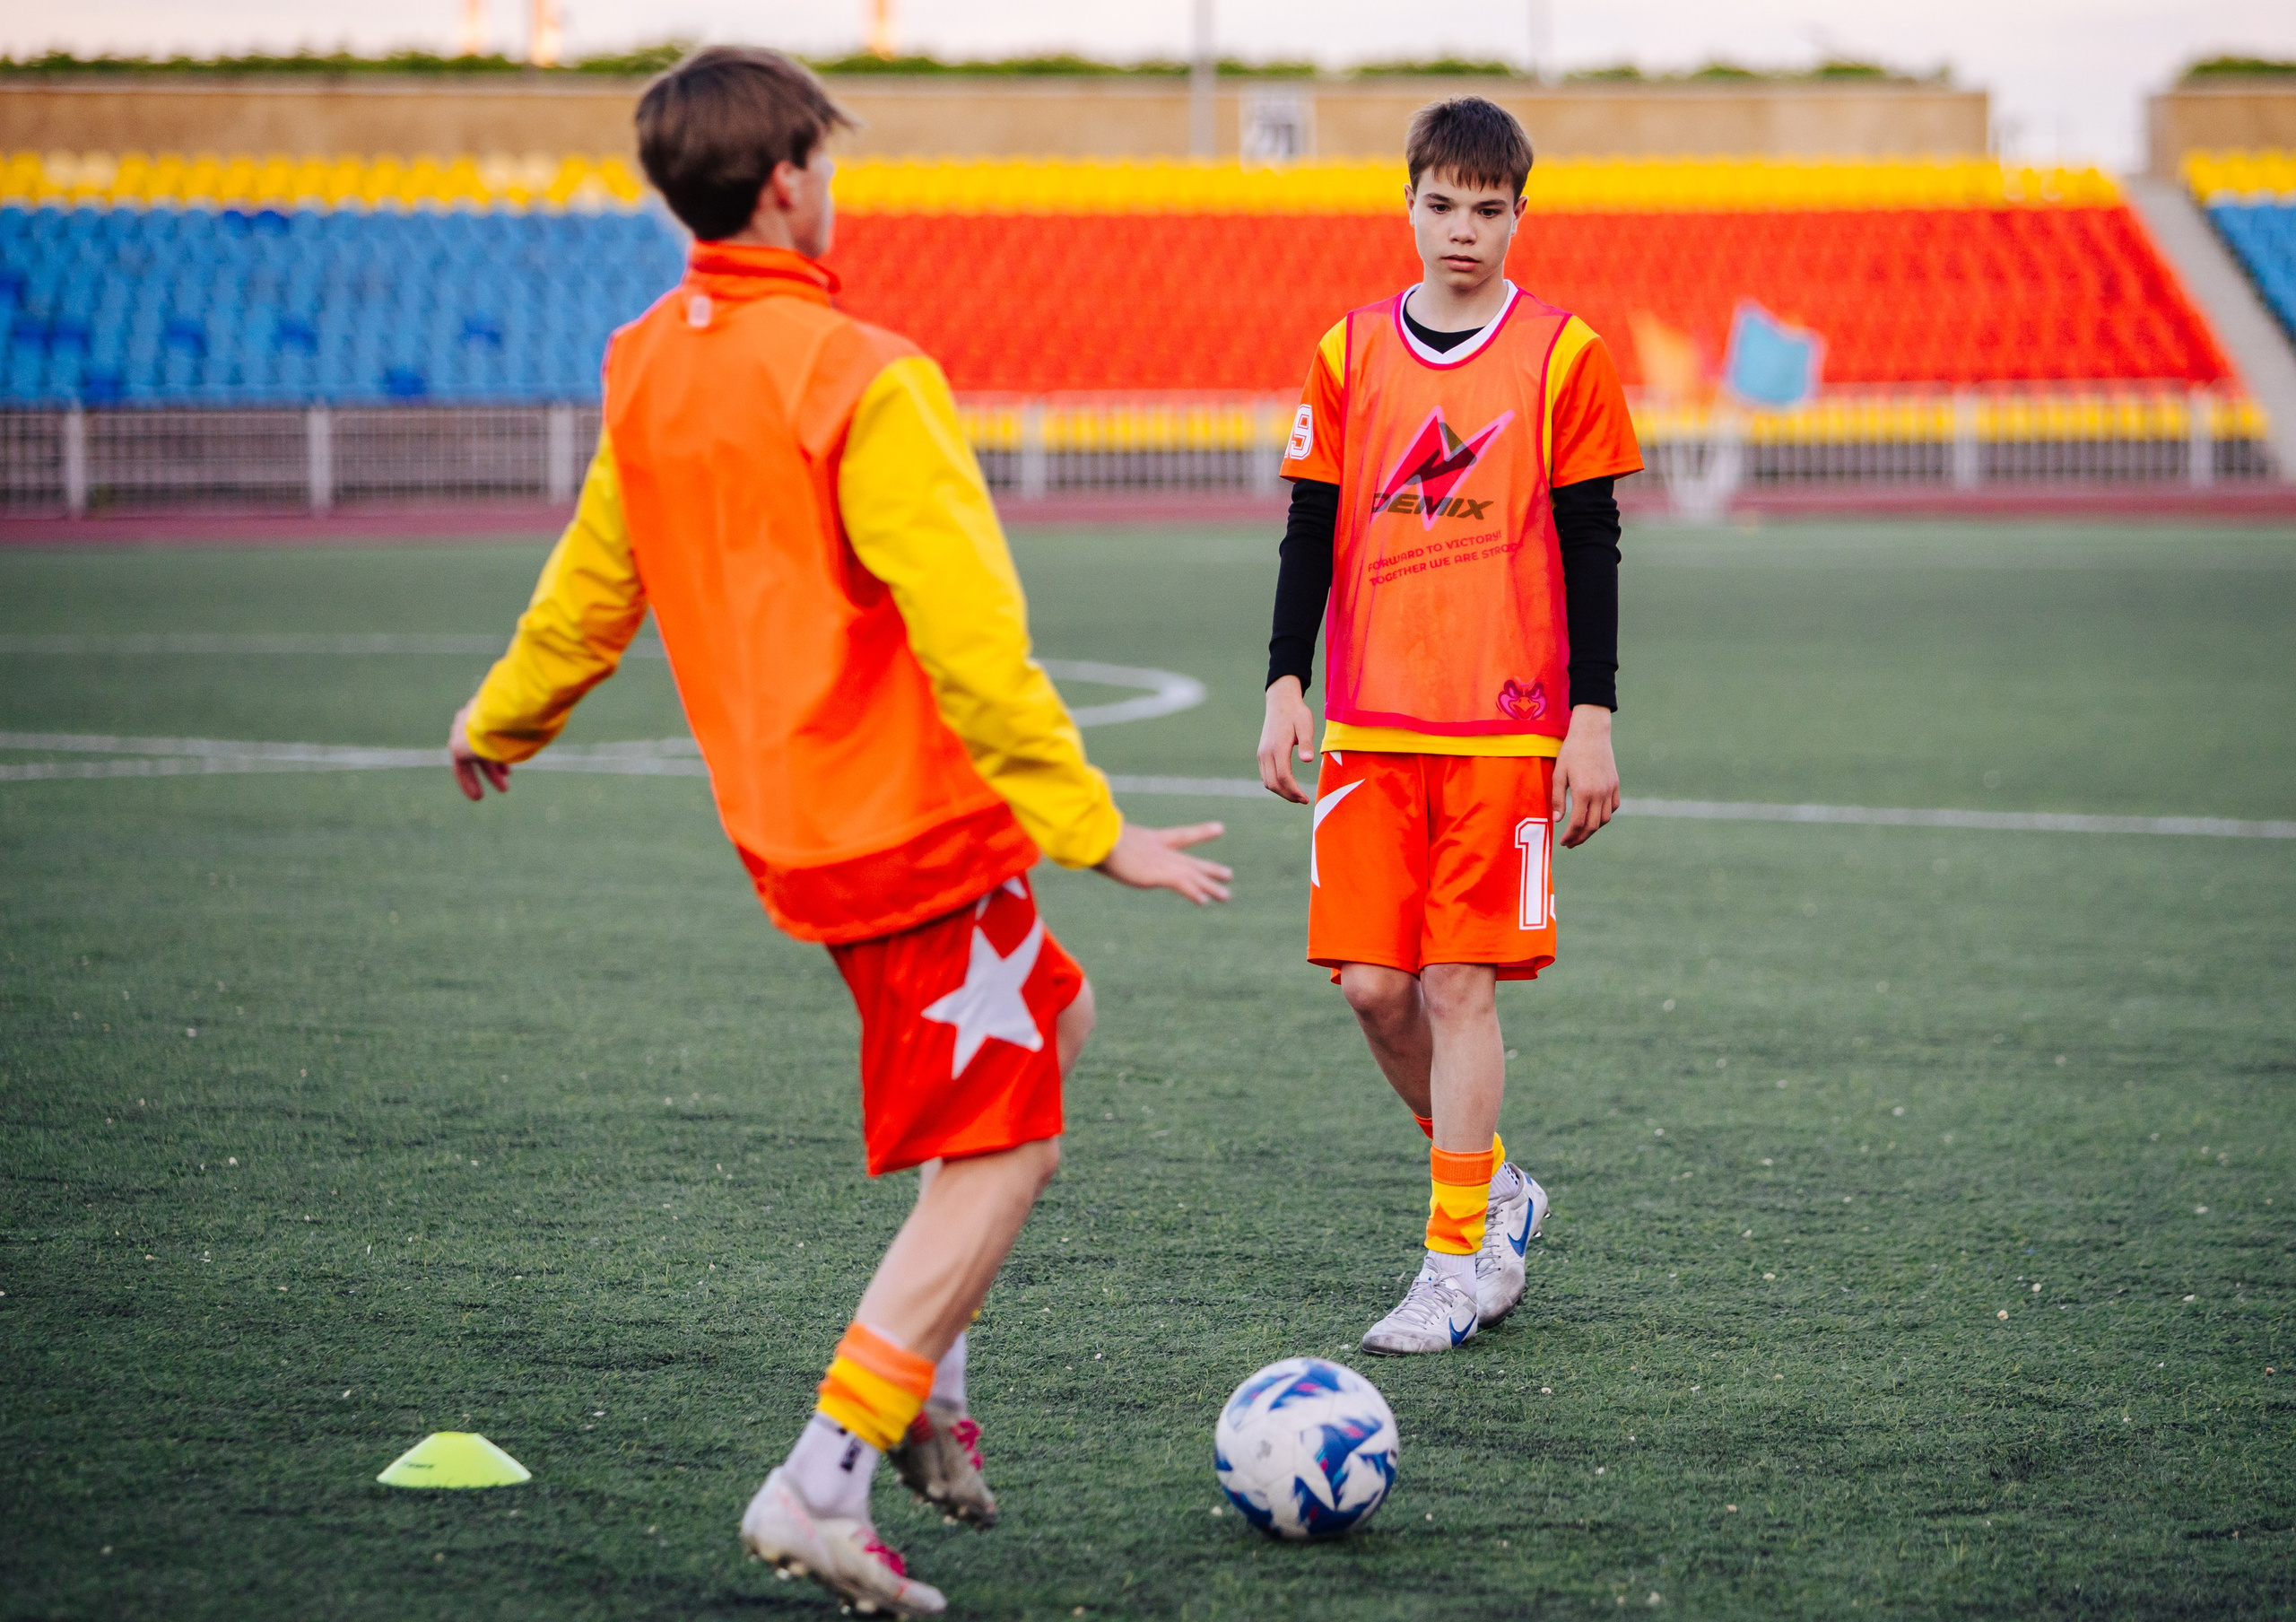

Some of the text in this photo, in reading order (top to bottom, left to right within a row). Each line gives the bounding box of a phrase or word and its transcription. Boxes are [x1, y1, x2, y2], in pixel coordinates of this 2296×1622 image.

[1284, 404, 1313, 460] 9
[1371, 493, 1494, 520] DEMIX
[1368, 530, 1502, 572] FORWARD TO VICTORY!
[1369, 562, 1427, 587] TOGETHER
[1430, 556, 1451, 568] WE
[1454, 552, 1479, 564] ARE
[1515, 817, 1556, 930] 1
